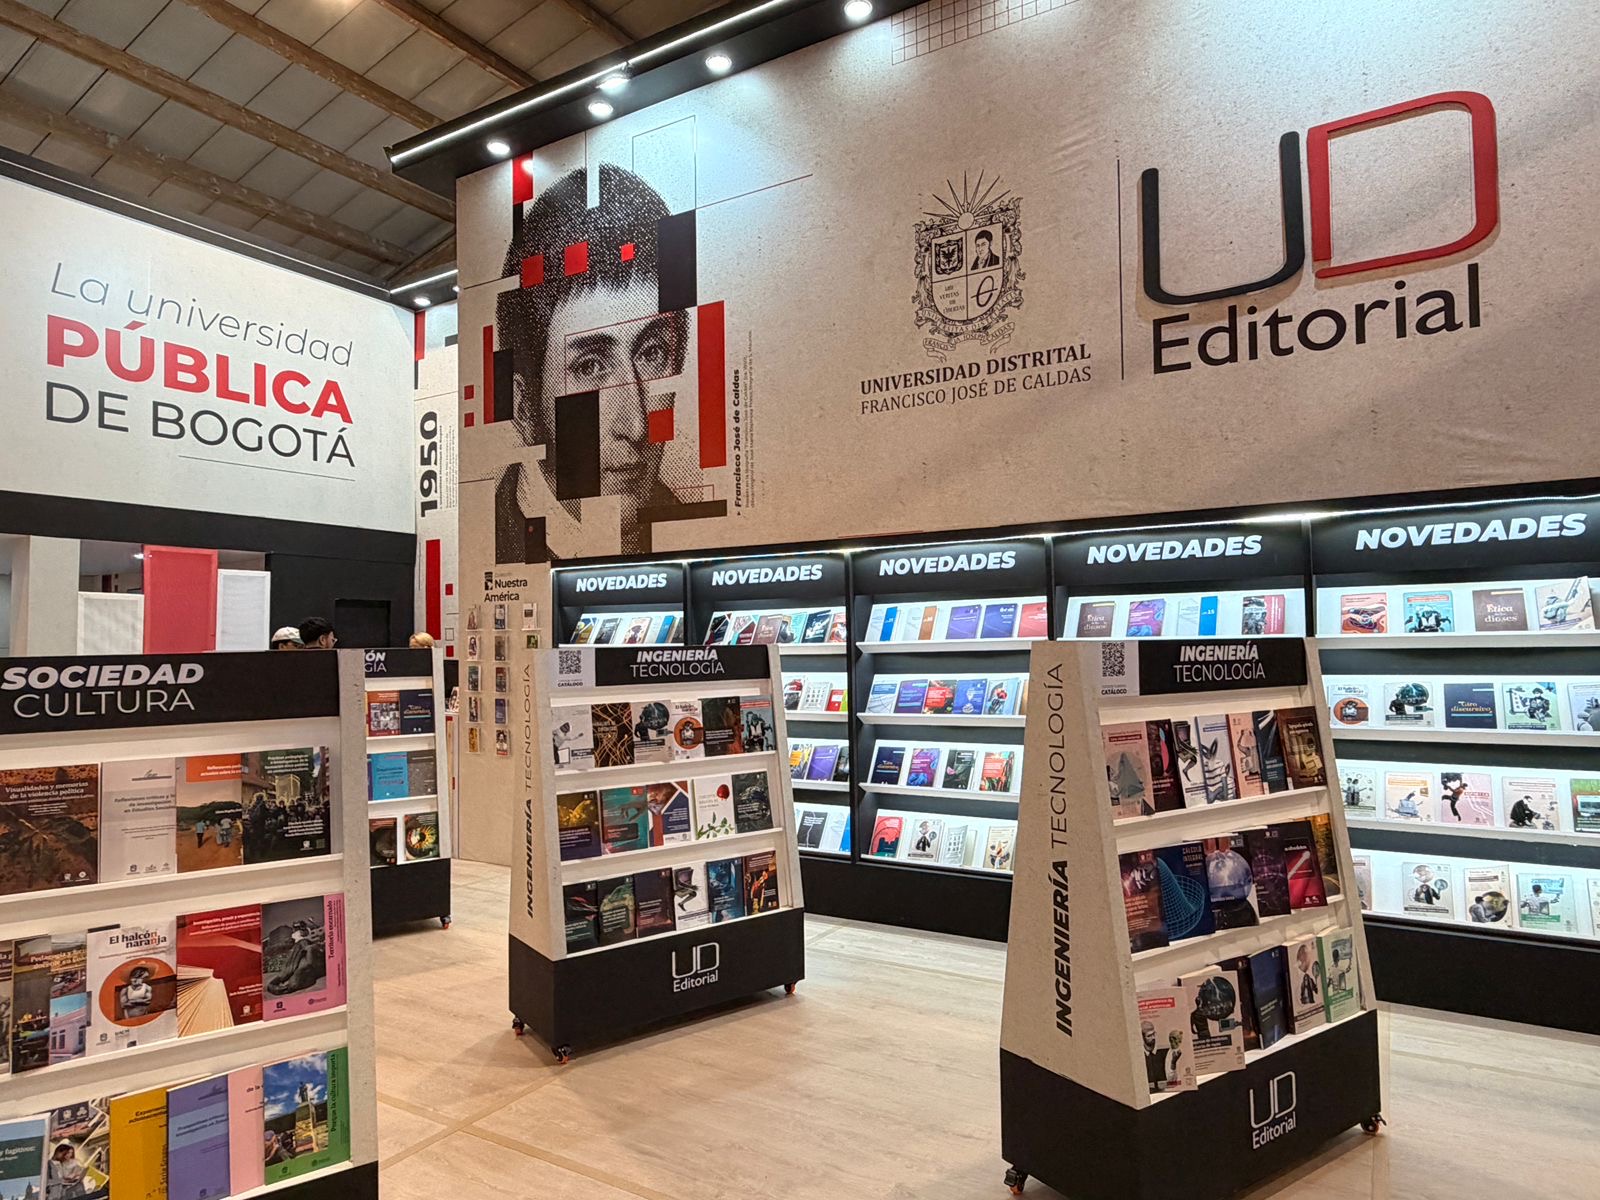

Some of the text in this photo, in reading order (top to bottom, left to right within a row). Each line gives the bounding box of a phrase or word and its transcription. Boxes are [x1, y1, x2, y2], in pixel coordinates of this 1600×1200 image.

[1142, 91, 1498, 305] UD
[51, 262, 353, 366] La universidad
[1152, 263, 1481, 374] Editorial
[47, 314, 353, 424] PÚBLICA
[860, 344, 1091, 395] UNIVERSIDAD DISTRITAL
[861, 366, 1091, 415] FRANCISCO JOSÉ DE CALDAS
[46, 381, 355, 467] DE BOGOTÁ
[733, 410, 740, 424] de
[733, 427, 741, 451] José
[420, 411, 438, 517] 1950
[734, 454, 743, 507] Francisco
[1355, 512, 1588, 551] NOVEDADES
[879, 550, 1016, 576] NOVEDADES
[1087, 534, 1262, 565] NOVEDADES
[494, 579, 528, 589] Nuestra
[576, 573, 668, 592] NOVEDADES
[711, 564, 823, 586] NOVEDADES
[484, 591, 520, 602] América
[637, 646, 718, 663] INGENIERÍA
[1180, 641, 1260, 662] INGENIERÍA
[1, 663, 205, 690] SOCIEDAD
[630, 659, 725, 678] TECNOLOGÍA
[1173, 661, 1266, 683] TECNOLOGÍA
[13, 689, 195, 718] CULTURA
[523, 664, 534, 919] INGENIERÍA TECNOLOGÍA
[1043, 663, 1073, 1037] INGENIERÍA TECNOLOGÍA
[109, 930, 158, 944] El halcón
[126, 935, 167, 948] naranja
[672, 942, 719, 979] UD
[673, 969, 719, 993] Editorial
[1250, 1070, 1297, 1129] UD
[1252, 1112, 1296, 1150] Editorial
